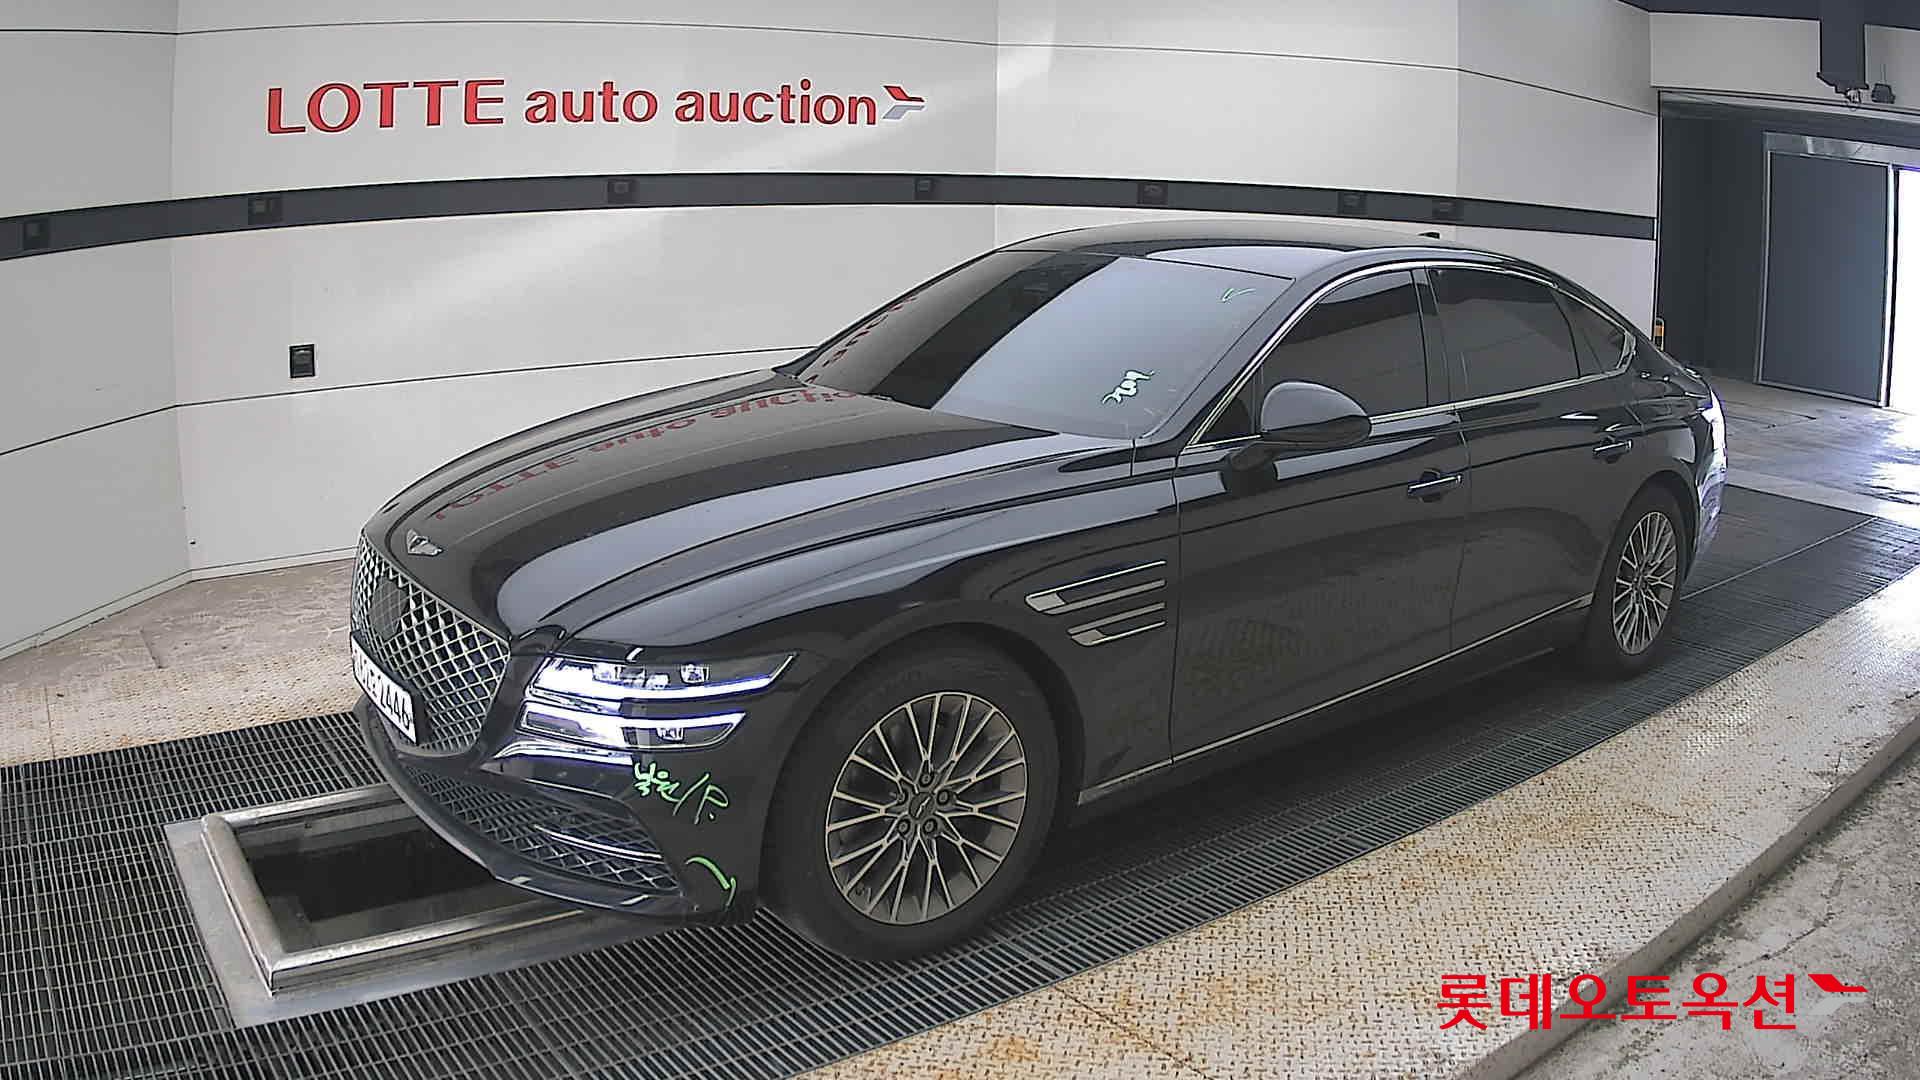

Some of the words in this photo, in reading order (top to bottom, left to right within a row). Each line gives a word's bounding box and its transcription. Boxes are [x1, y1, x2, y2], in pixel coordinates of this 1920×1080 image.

[267, 79, 504, 134] LOTTE
[525, 82, 658, 124] auto
[674, 79, 877, 125] auction
